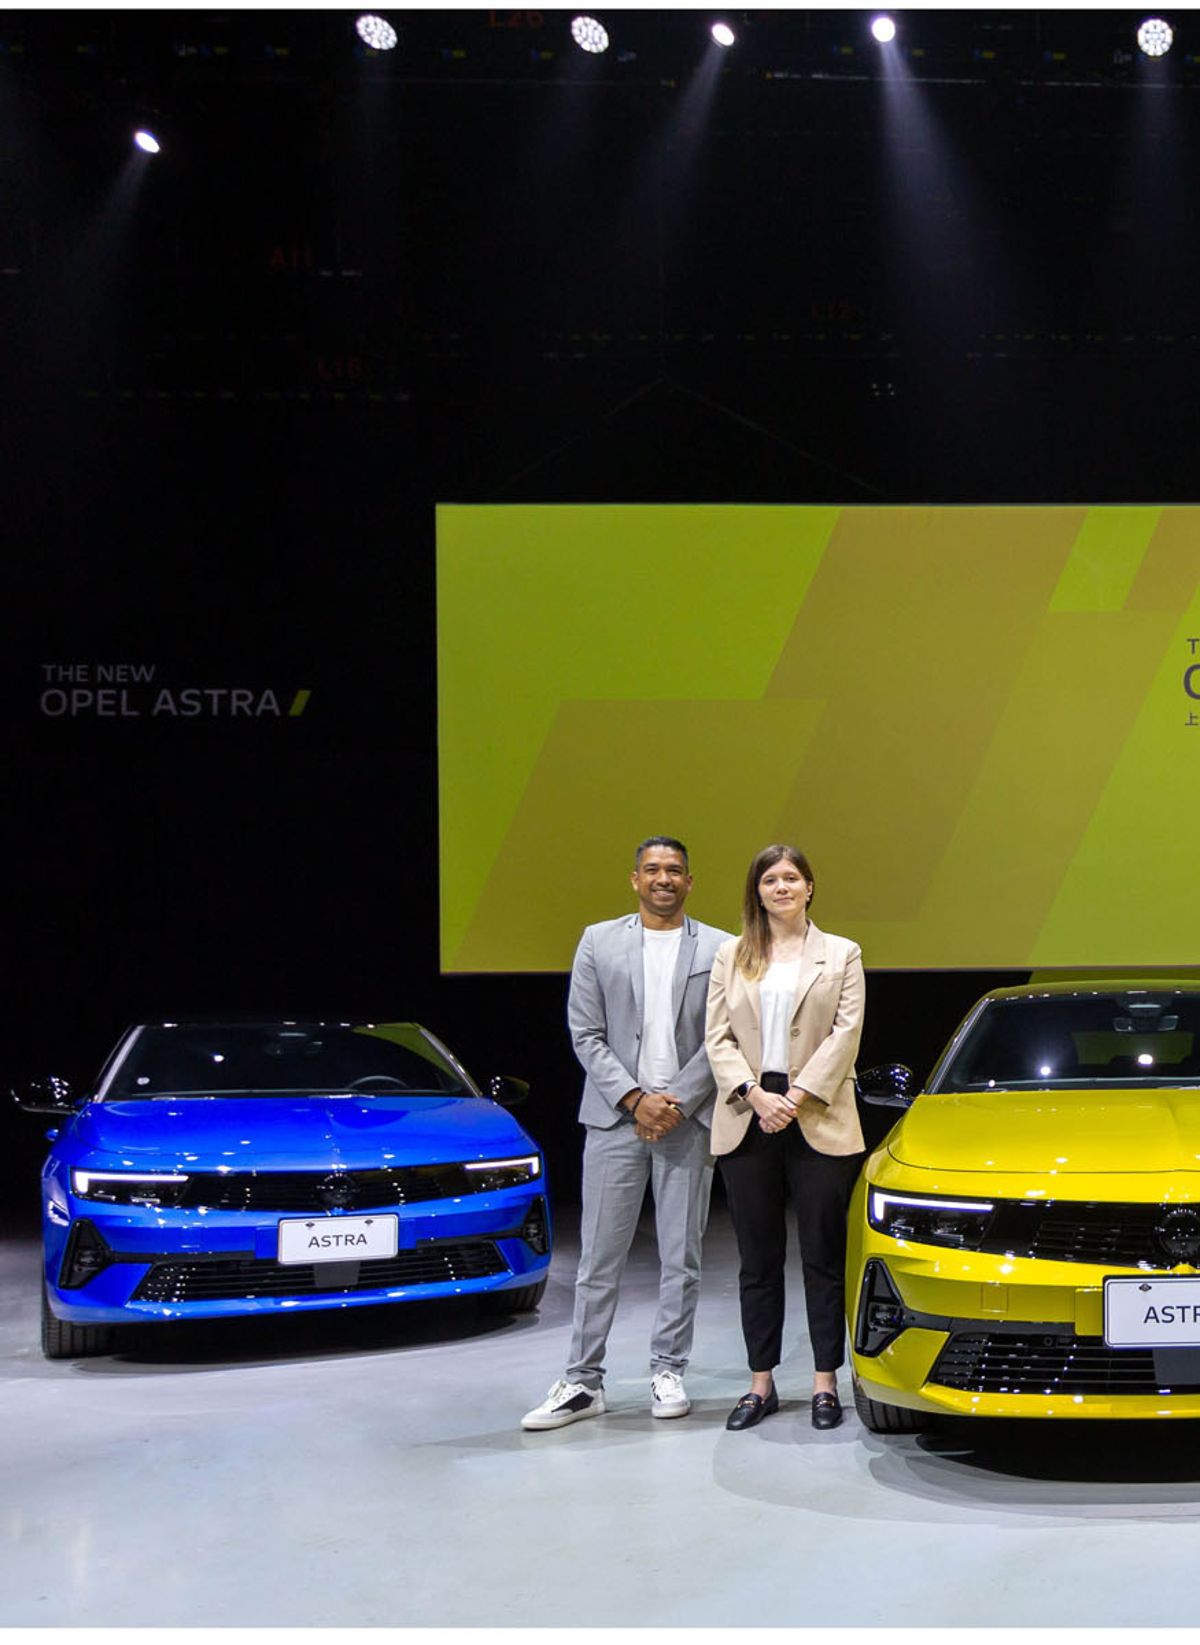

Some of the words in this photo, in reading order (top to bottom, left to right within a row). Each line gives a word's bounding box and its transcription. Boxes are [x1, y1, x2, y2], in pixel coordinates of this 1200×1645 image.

[41, 664, 89, 683] THE
[95, 664, 156, 683] NEW
[39, 688, 141, 717] OPEL
[150, 688, 281, 717] ASTRA
[308, 1233, 369, 1249] ASTRA
